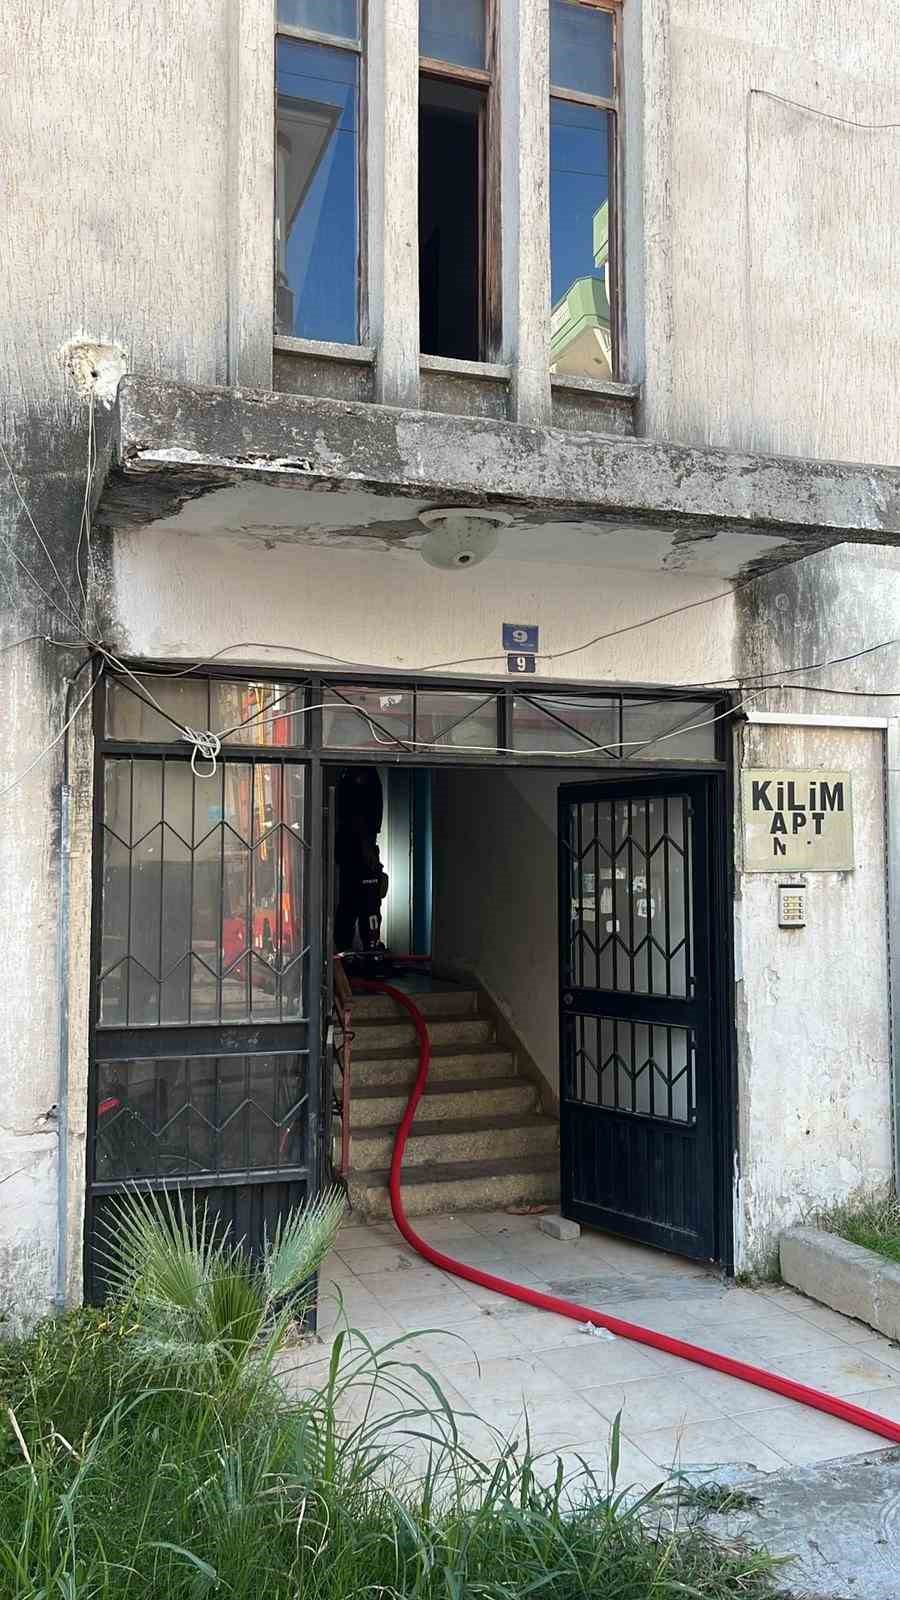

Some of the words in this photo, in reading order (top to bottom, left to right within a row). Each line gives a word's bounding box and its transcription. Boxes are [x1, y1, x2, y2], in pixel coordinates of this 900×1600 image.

[512, 630, 528, 643] 9
[517, 656, 526, 671] 9
[770, 812, 824, 834] APT
